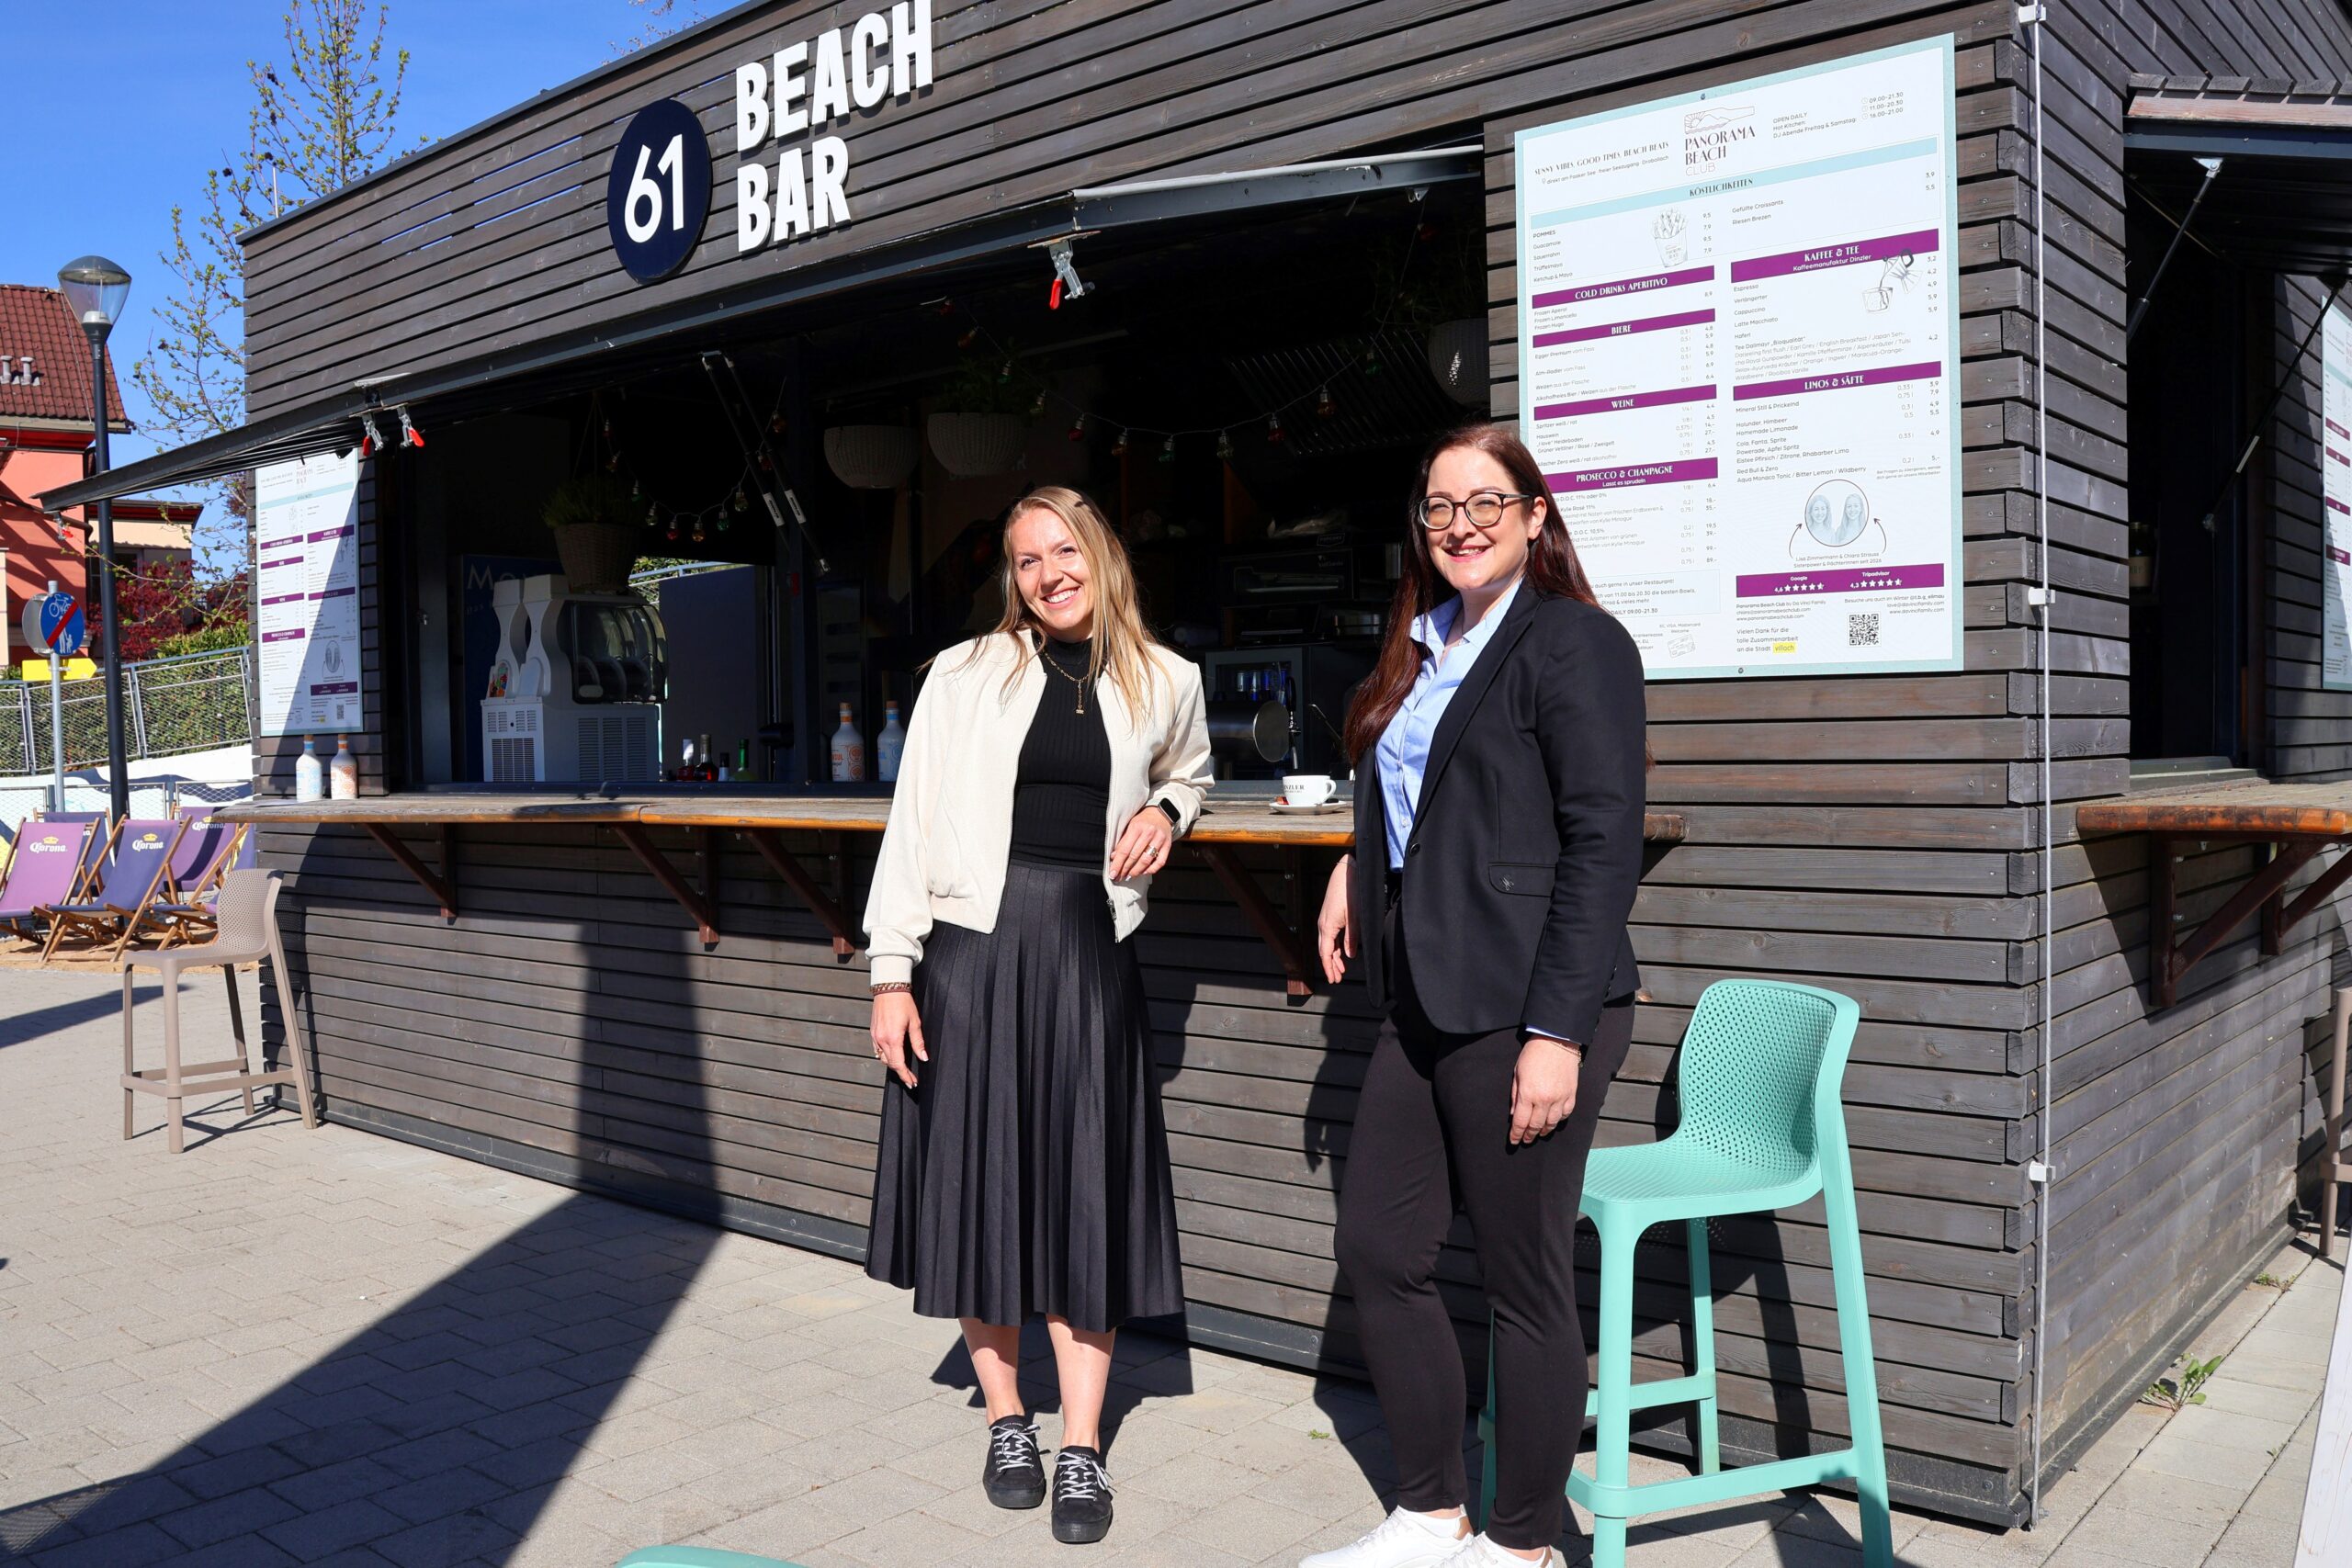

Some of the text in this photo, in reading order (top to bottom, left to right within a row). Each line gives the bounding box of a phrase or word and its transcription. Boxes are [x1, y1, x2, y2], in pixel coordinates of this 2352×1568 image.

[736, 0, 933, 152] BEACH
[1772, 111, 1807, 123] OPEN DAILY
[1781, 127, 1803, 138] Abende
[1804, 123, 1824, 133] Freitag
[1684, 124, 1755, 151] PANORAMA
[1577, 154, 1600, 167] GOOD
[1623, 145, 1646, 157] BEACH
[1685, 145, 1725, 165] BEACH
[1685, 161, 1715, 177] CLUB
[625, 133, 684, 243] 61
[1690, 175, 1753, 197] KÖSTLICHKEITEN
[737, 136, 851, 253] BAR
[1732, 198, 1782, 214] Gefüllte Croissants
[1752, 213, 1770, 221] Brezen
[1532, 230, 1555, 239] POMMES
[1804, 244, 1859, 262] KAFFEE & TEE
[1792, 253, 1871, 272] Kaffeemanufaktur Dinzler
[1575, 276, 1667, 299] COLD DRINKS APERITIVO
[1733, 282, 1758, 293] Espresso
[1734, 293, 1767, 305] Verlängerter
[1734, 306, 1765, 317] Cappuccino
[1611, 323, 1631, 334] BIERE
[1734, 316, 1778, 328] Latte Macchiato
[1735, 344, 1744, 352] Tee
[1745, 340, 1770, 350] Dallmayr
[1804, 373, 1864, 390] LIMOS & SÄFTE
[1611, 398, 1634, 409] WEINE
[1736, 405, 1756, 413] Mineral
[1773, 400, 1799, 409] Prickelnd
[1763, 416, 1787, 425] Himbeer
[1736, 423, 1798, 436] Homemade Limonade
[1767, 445, 1781, 453] Apfel
[1783, 443, 1799, 451] Spritz
[1803, 448, 1833, 457] Rhabarber
[1834, 446, 1849, 455] Limo
[1576, 464, 1672, 482] PROSECCO & CHAMPAGNE
[1736, 465, 1866, 484] Aqua Monaco Tonic Bitter Lemon Wildberry
[1623, 477, 1645, 485] sprudeln
[1861, 570, 1890, 578] Tripadvisor
[1750, 635, 1798, 643] Zusammenarbeit
[29, 841, 67, 853] Corona
[132, 839, 164, 852] Corona
